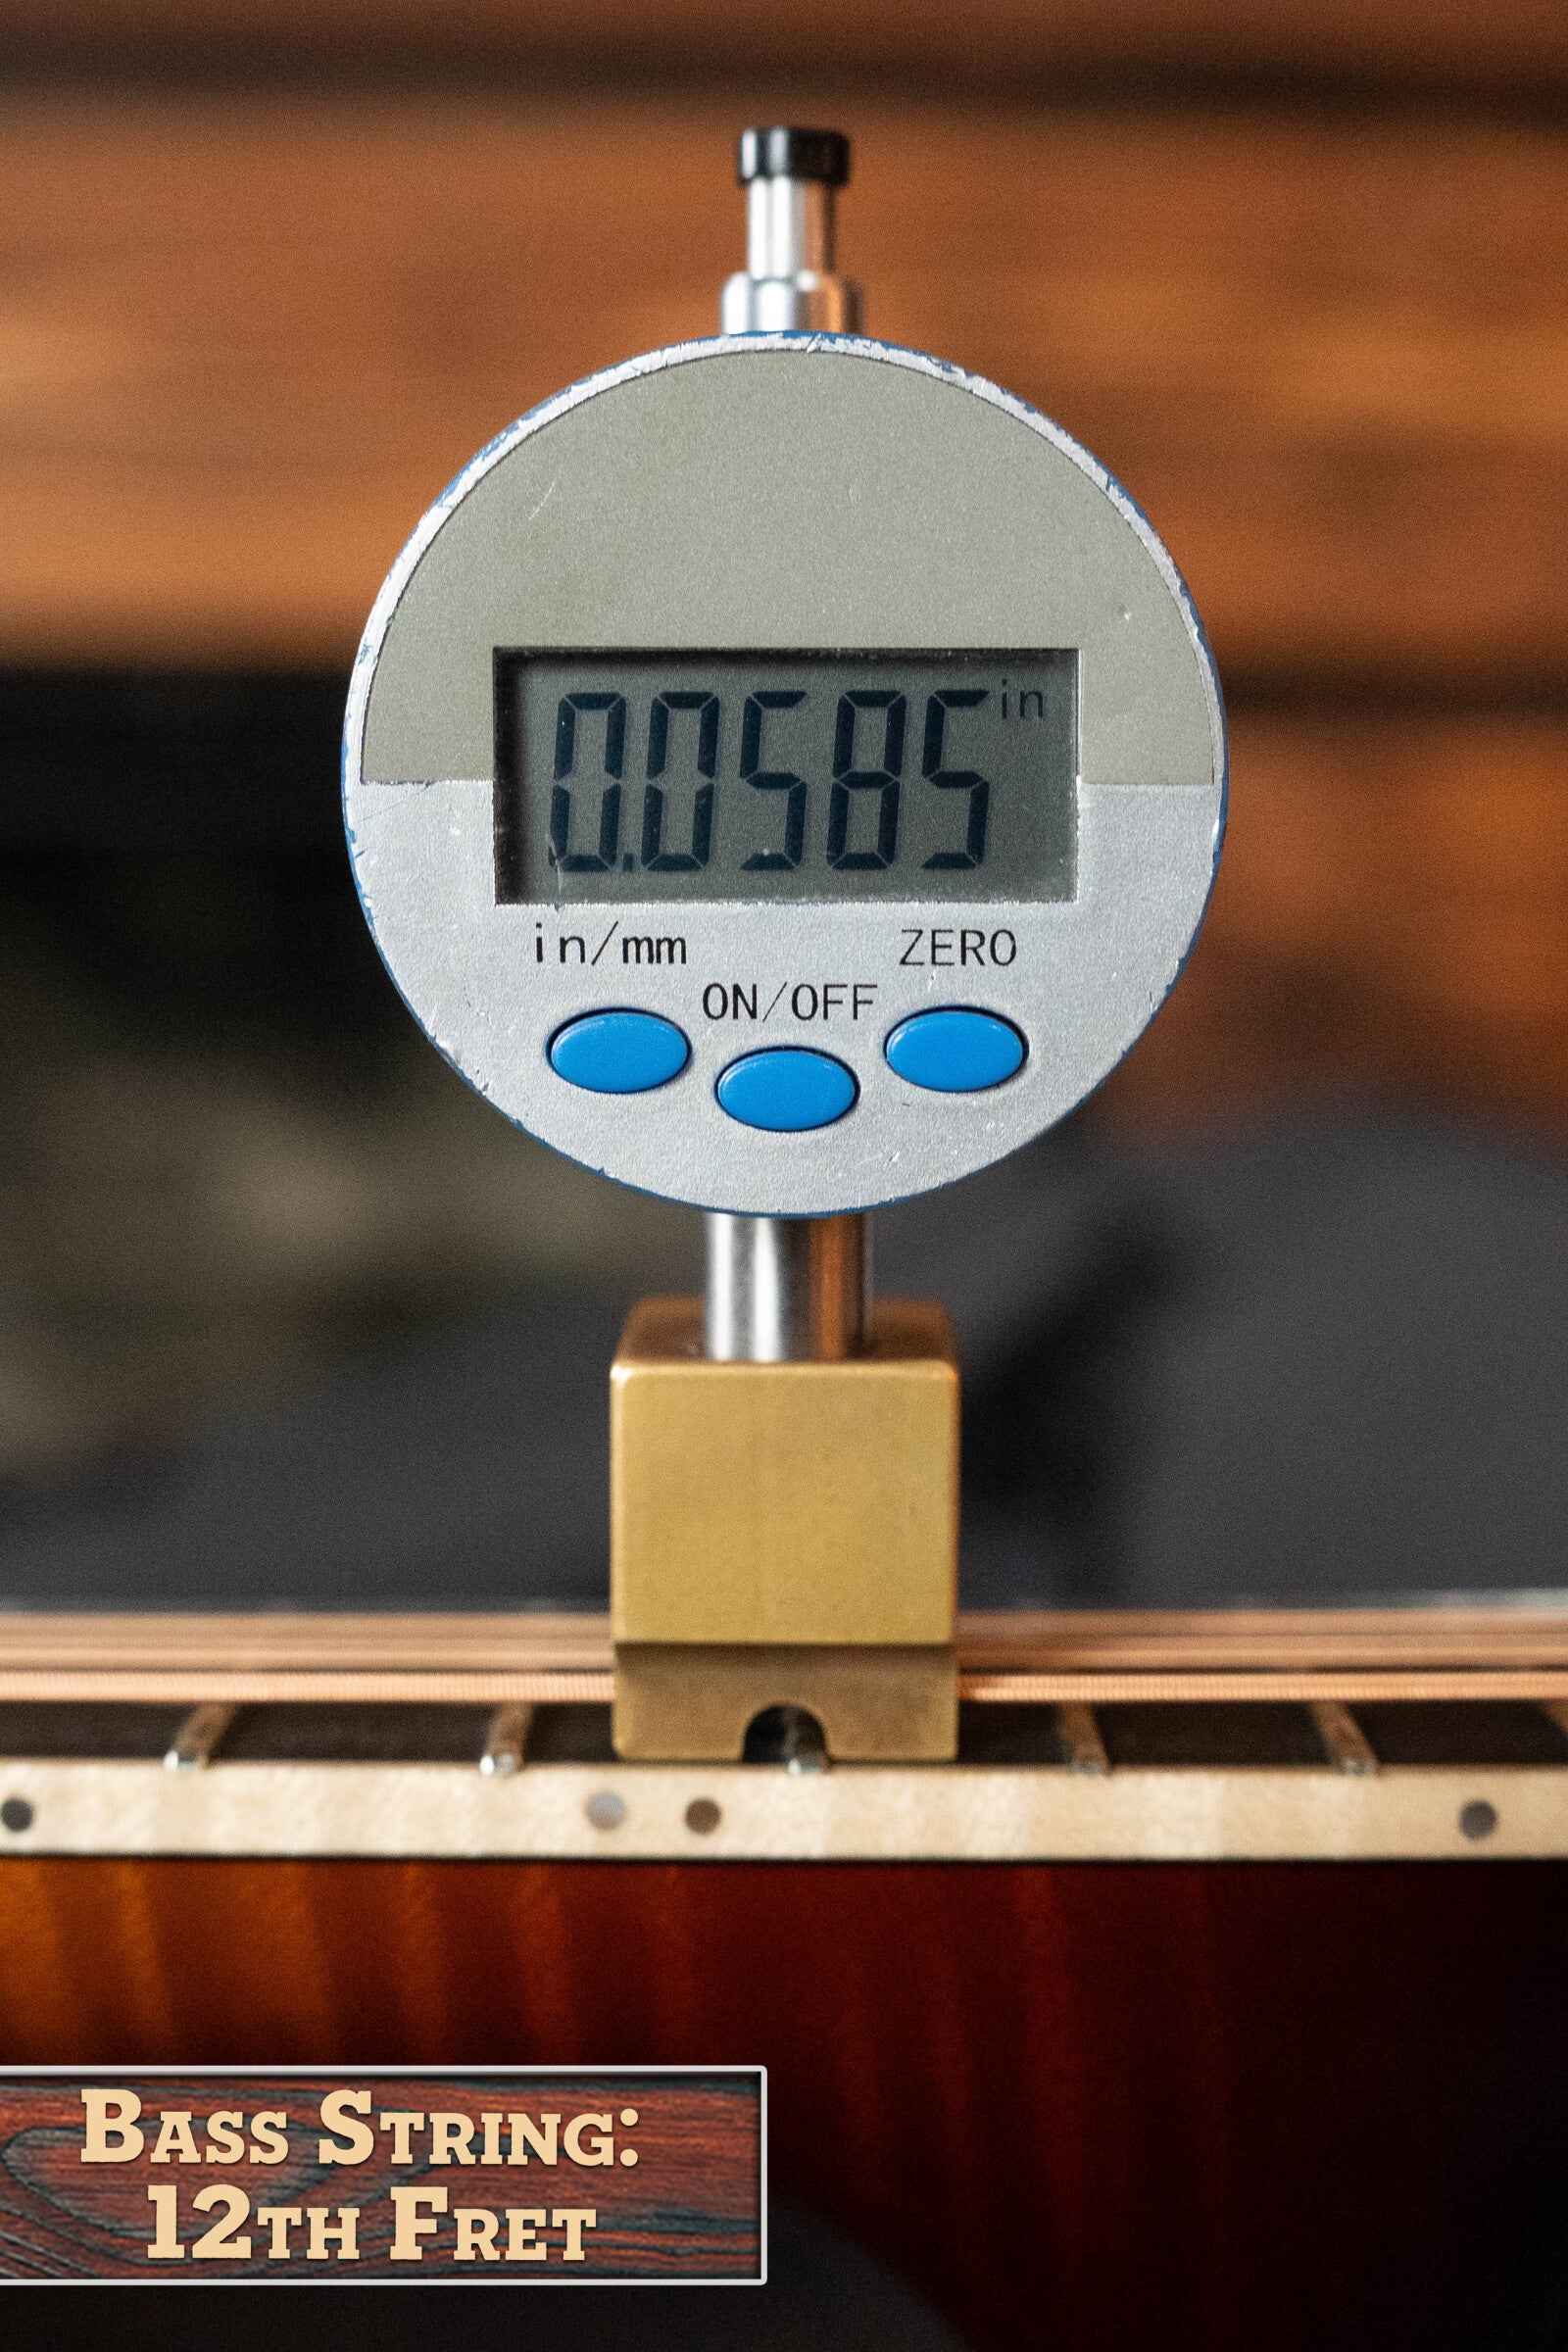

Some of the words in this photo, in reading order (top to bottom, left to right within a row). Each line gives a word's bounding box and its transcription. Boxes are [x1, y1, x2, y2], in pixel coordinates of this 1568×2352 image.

[549, 689, 989, 872] 0.0585
[1000, 678, 1046, 719] in
[535, 921, 687, 965] in/mm
[899, 929, 1017, 966] ZERO
[702, 982, 878, 1022] ON/OFF
